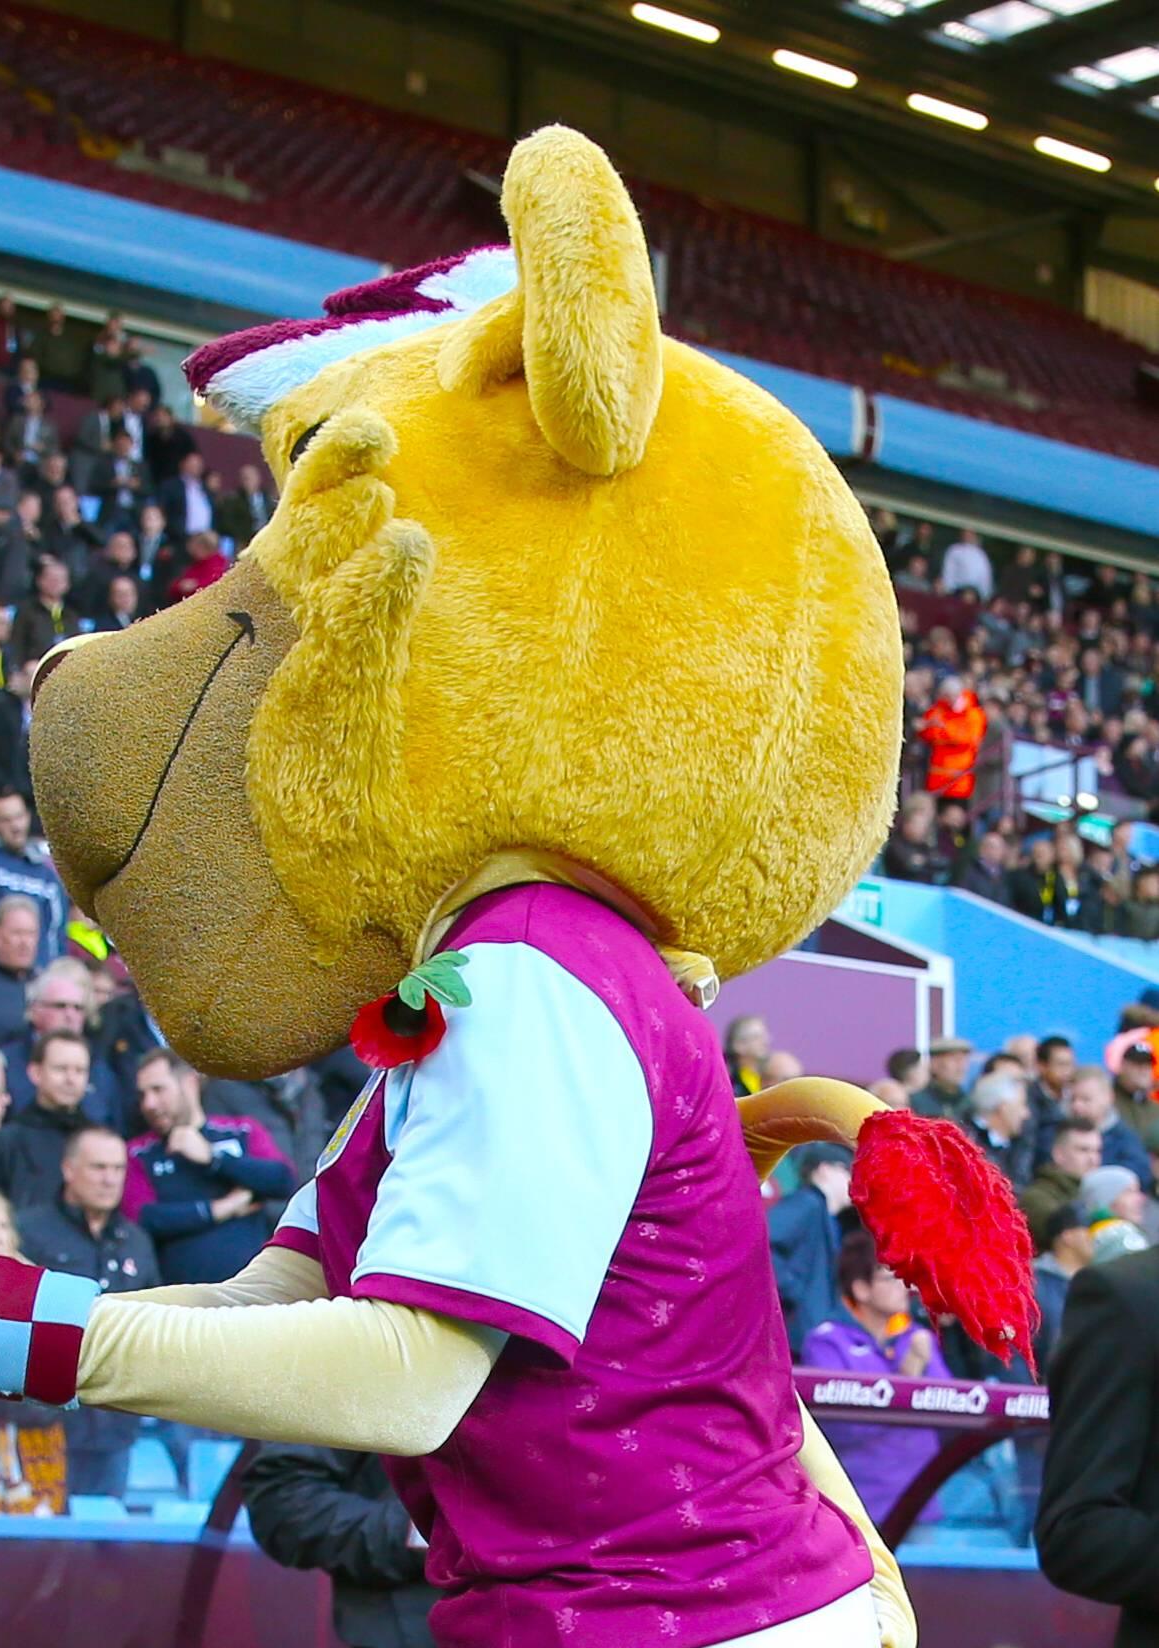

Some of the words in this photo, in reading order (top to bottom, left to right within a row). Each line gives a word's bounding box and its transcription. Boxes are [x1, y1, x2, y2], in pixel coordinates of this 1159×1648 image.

[813, 1379, 872, 1405] utilita
[911, 1386, 970, 1413] utilita
[1005, 1391, 1049, 1419] utilit
